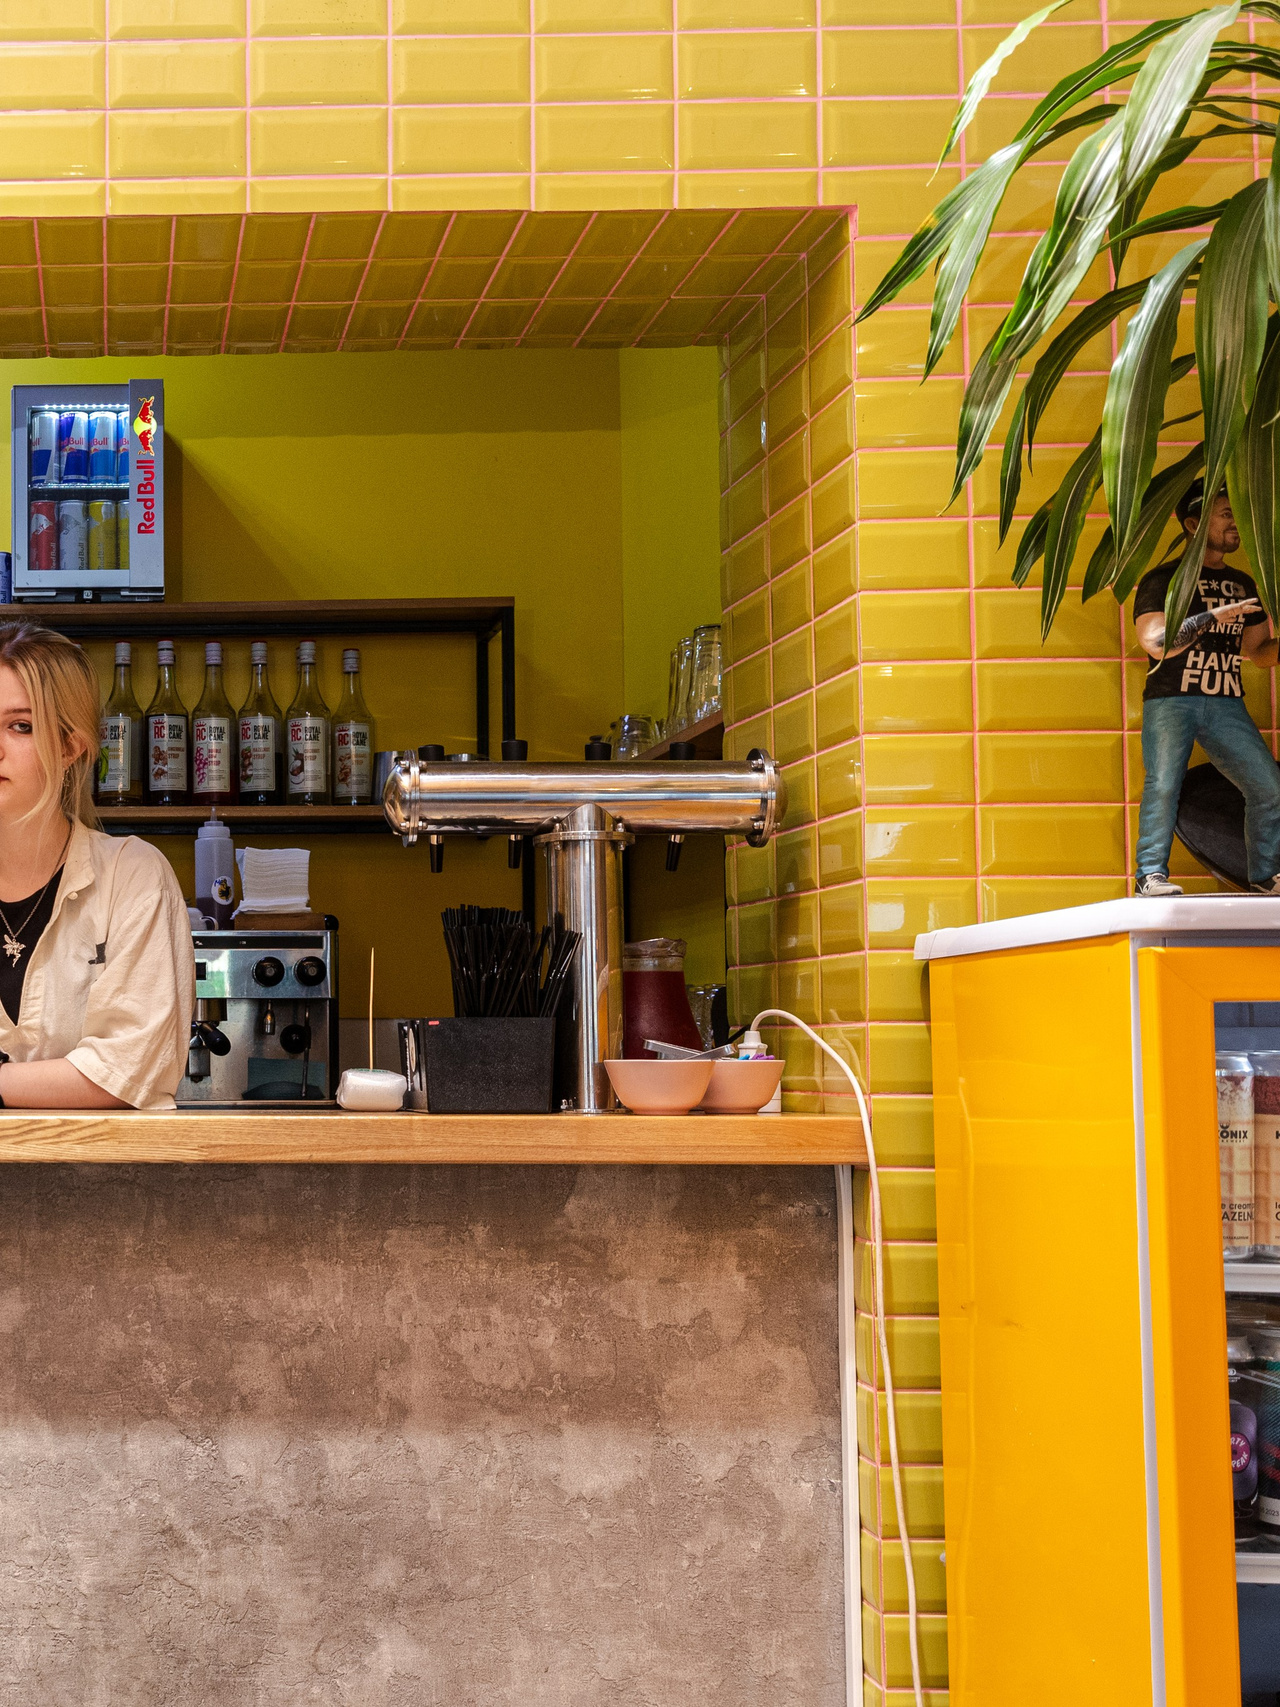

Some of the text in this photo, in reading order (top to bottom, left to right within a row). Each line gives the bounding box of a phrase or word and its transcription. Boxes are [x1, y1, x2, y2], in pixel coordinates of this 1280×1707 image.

[136, 460, 155, 534] Red Bull
[1186, 650, 1244, 672] HAVE
[1180, 669, 1241, 697] FUN
[154, 726, 165, 739] RC
[196, 728, 206, 741] RC
[241, 727, 250, 740] RC
[291, 728, 301, 742] RC
[338, 733, 349, 746] RC
[1218, 1130, 1248, 1139] ONIX
